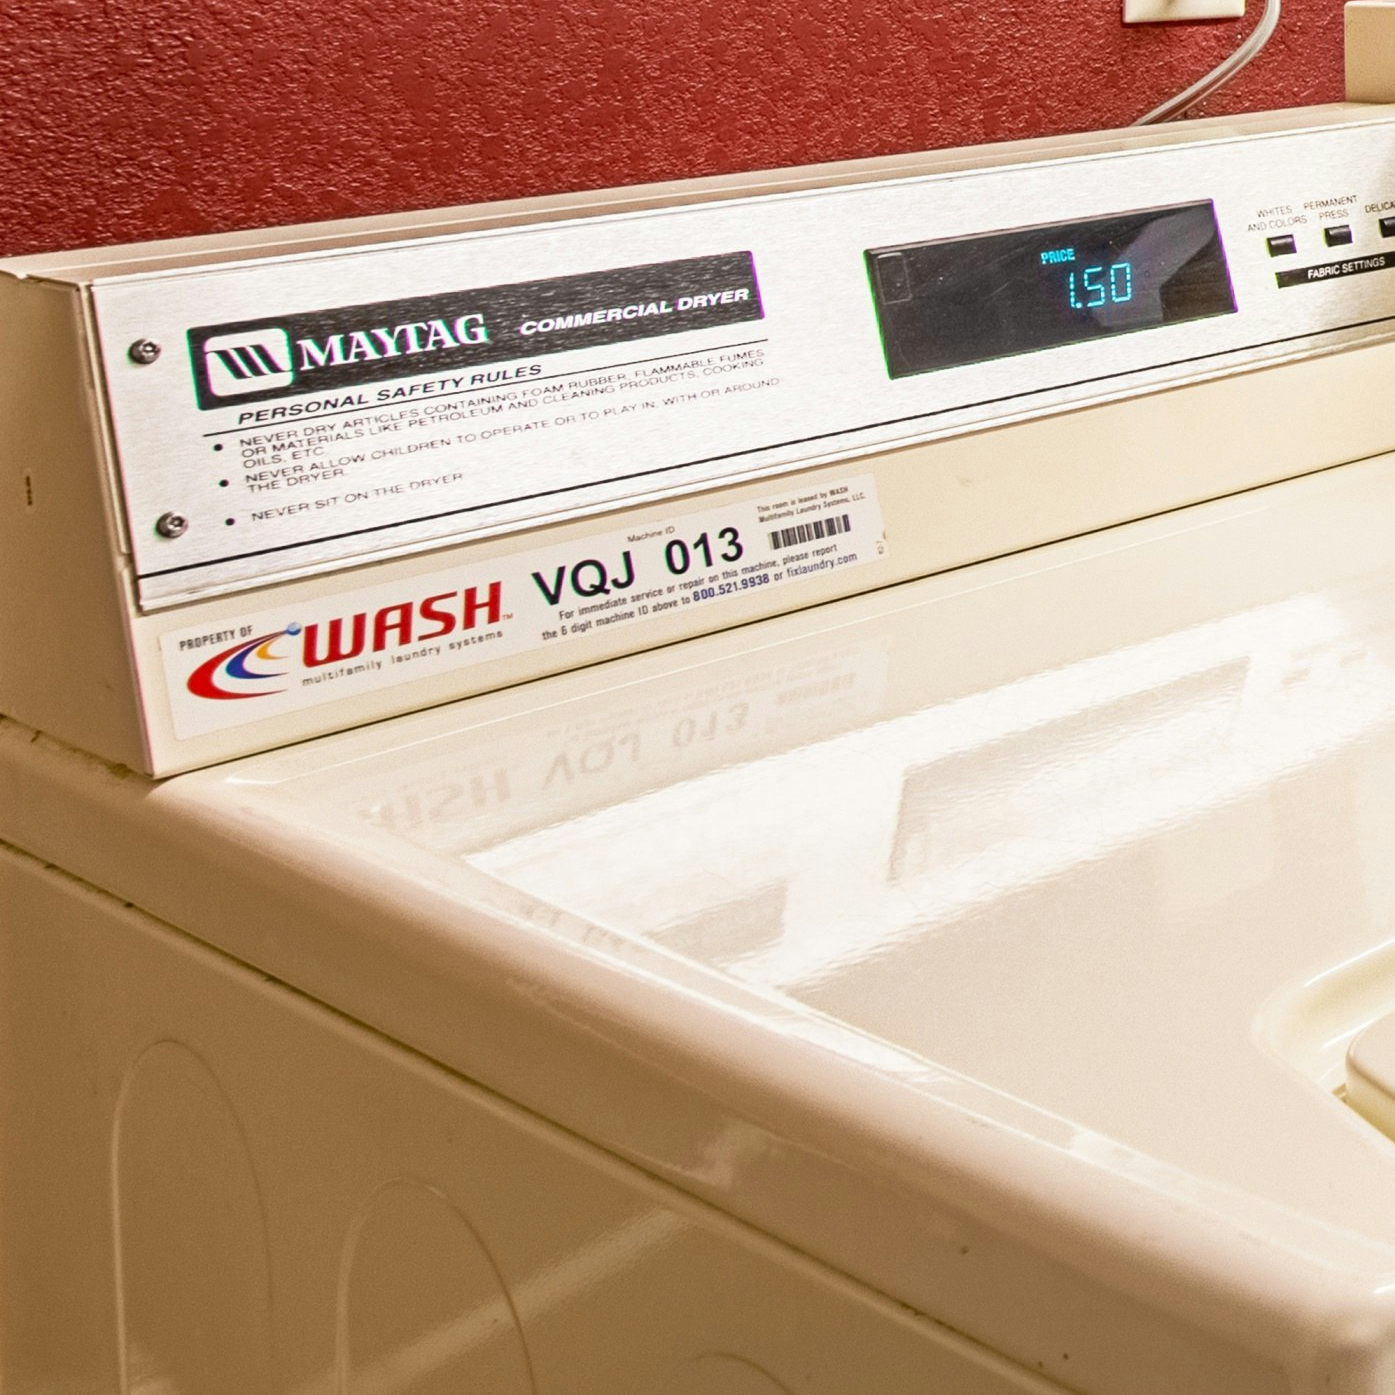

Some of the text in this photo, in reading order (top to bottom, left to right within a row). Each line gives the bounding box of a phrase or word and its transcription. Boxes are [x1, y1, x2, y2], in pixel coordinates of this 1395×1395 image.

[1248, 215, 1308, 232] AND COLORS
[1257, 206, 1293, 218] WHITES
[1303, 195, 1358, 210] PERMANENT
[1319, 209, 1348, 220] PRESS
[1041, 248, 1076, 265] PRICE
[1308, 257, 1385, 279] FABRIC SETTINGS
[1069, 262, 1132, 309] 1.50
[296, 288, 750, 371] MAYTAG COMMERCIAL DRYER
[237, 364, 542, 425] PERSONAL SAFETY RULES
[239, 429, 298, 447] NEVER
[301, 422, 337, 436] DRY
[341, 408, 419, 429] ARTICLES
[422, 391, 518, 415] CONTAINING
[521, 383, 564, 397] FOAM
[634, 357, 712, 378] FLAMMABLE
[718, 348, 764, 363] FUMES
[240, 445, 267, 458] OR
[271, 428, 364, 452] MATERIALS
[368, 422, 400, 435] LIKE
[407, 403, 503, 428] PETROLEUM
[507, 398, 538, 410] AND
[542, 384, 615, 404] CLEANING
[702, 358, 763, 375] COOKING
[244, 464, 305, 483] NEVER
[307, 453, 366, 471] ALLOW
[369, 437, 451, 460] CHILDREN
[456, 432, 477, 444] TO
[479, 419, 548, 439] OPERATE
[553, 414, 576, 426] OR
[580, 410, 599, 421] TO
[602, 403, 637, 416] PLAY
[662, 392, 697, 405] WITH
[699, 388, 720, 398] OR
[723, 377, 780, 394] AROUND
[247, 479, 281, 493] THE
[250, 472, 463, 521] NEVER SIT ON THE DRYER
[626, 525, 675, 543] Machine ID
[531, 526, 744, 606] VQJ 013
[557, 607, 575, 621] For
[576, 595, 628, 616] immediate
[629, 588, 664, 603] service
[665, 584, 676, 594] or
[677, 577, 706, 591] repair
[707, 573, 720, 583] on
[720, 568, 739, 580] this
[781, 551, 810, 565] please
[810, 543, 838, 557] report
[541, 551, 858, 640] the 6 digit machine ID above to 800.521.9938 or fixlaundry.com
[178, 624, 253, 651] PROPERTY OF
[303, 581, 502, 668] WASH
[301, 630, 503, 686] multifamily laundry systems
